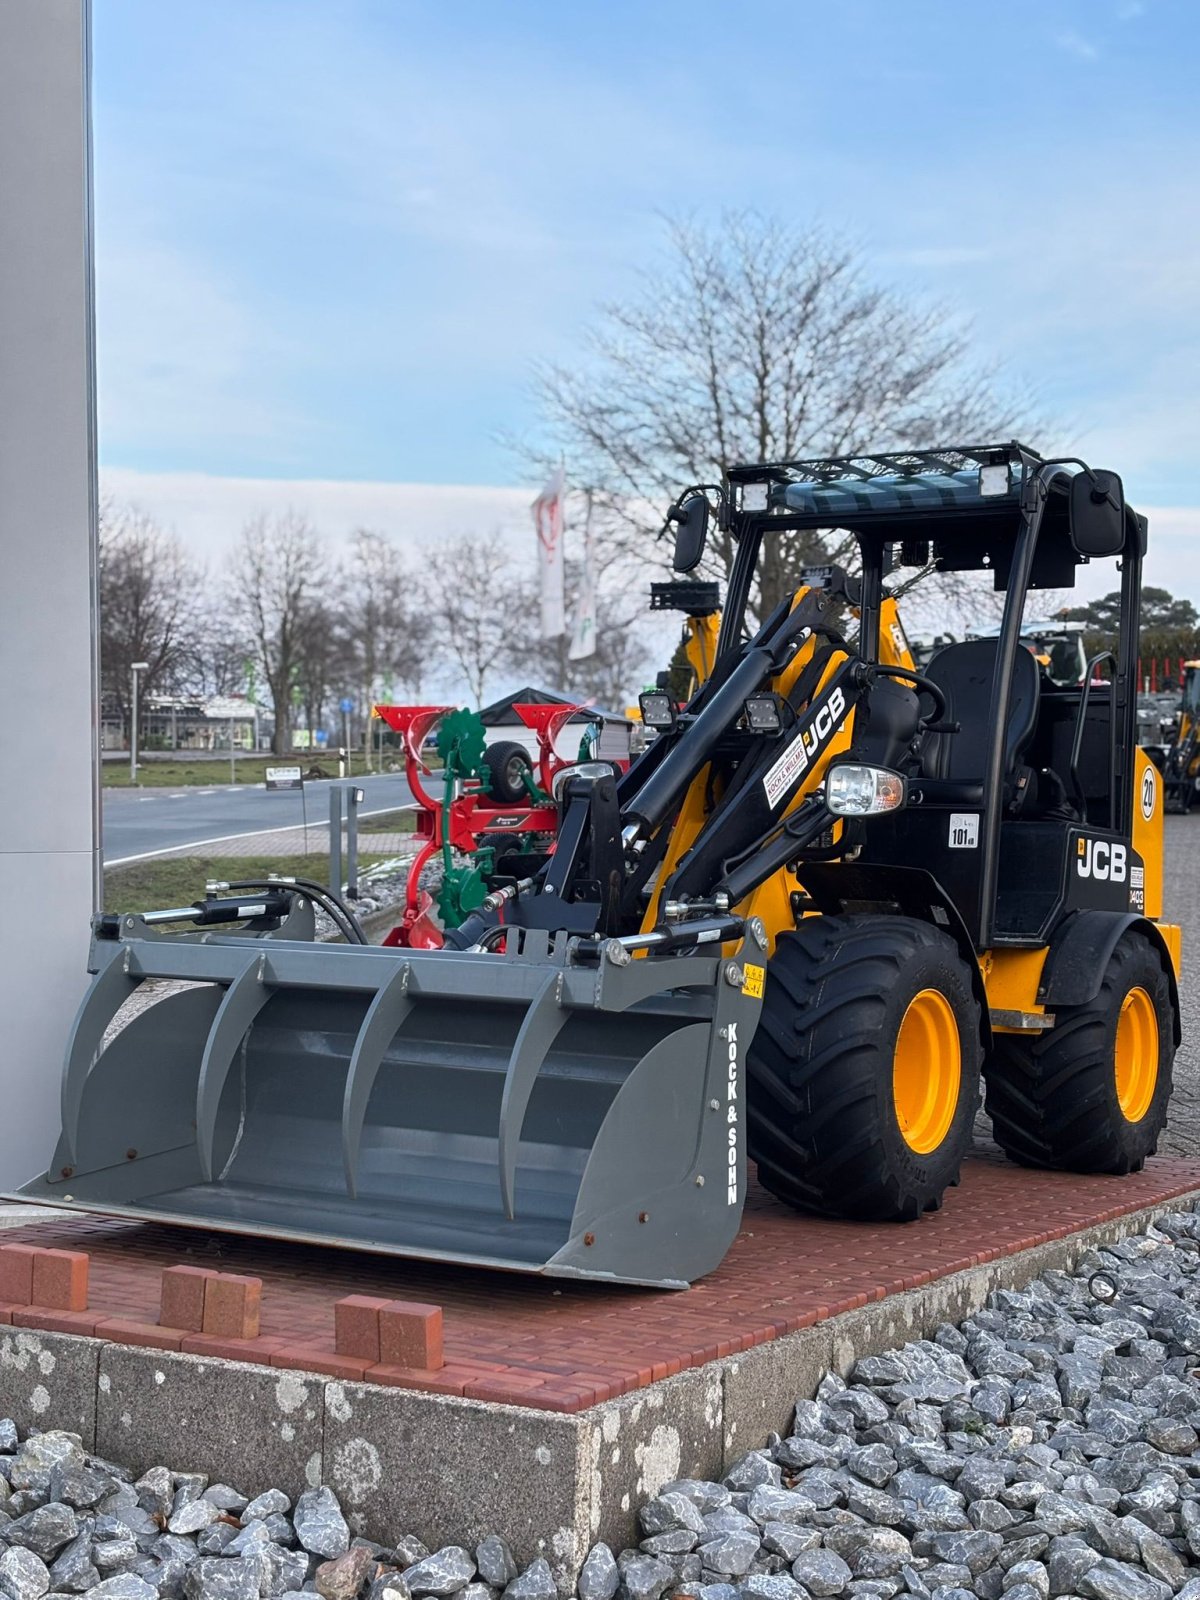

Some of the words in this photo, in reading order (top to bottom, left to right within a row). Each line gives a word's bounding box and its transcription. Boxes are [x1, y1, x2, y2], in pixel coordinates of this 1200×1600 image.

[806, 686, 845, 757] JCB
[768, 774, 781, 796] KOCH
[1143, 779, 1153, 808] 20
[953, 828, 968, 845] 101
[1077, 839, 1127, 882] JCB
[727, 1022, 738, 1101] KOCK
[727, 1105, 738, 1124] &
[727, 1127, 737, 1206] SOHN
